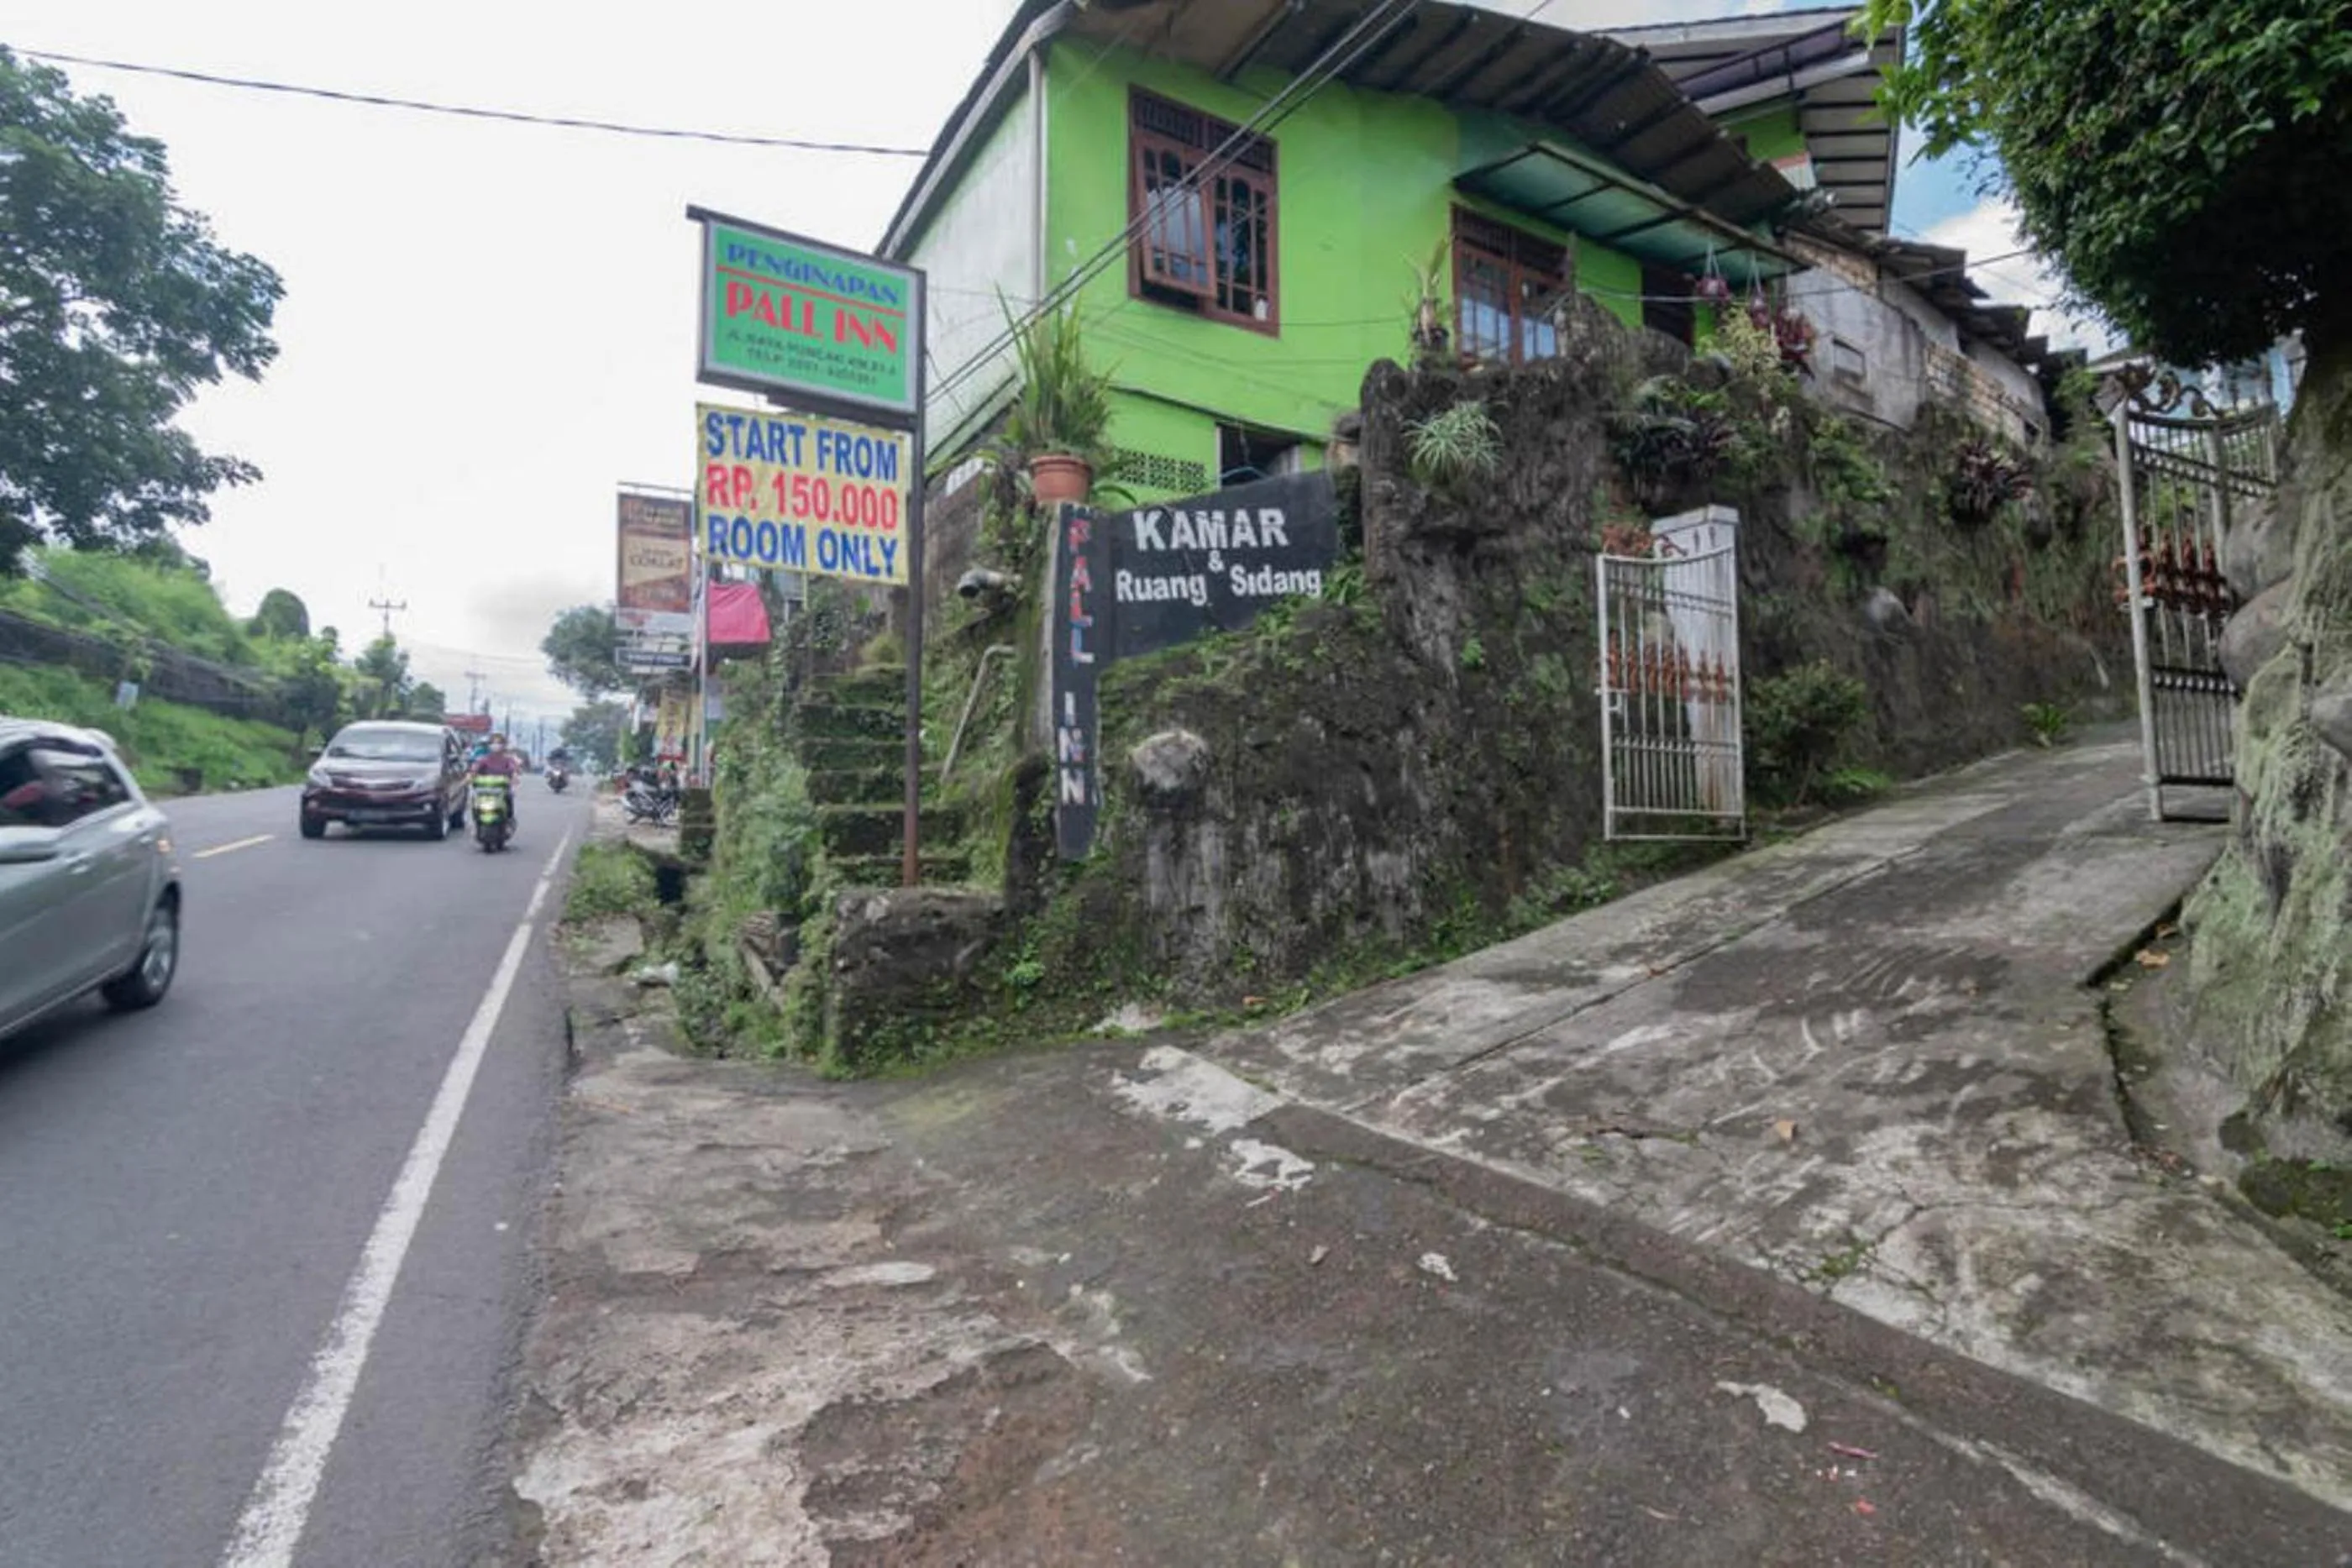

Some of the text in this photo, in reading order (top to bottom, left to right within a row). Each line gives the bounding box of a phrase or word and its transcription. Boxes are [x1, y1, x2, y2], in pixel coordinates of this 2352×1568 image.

[727, 243, 899, 305] PENGINAPAN
[726, 281, 898, 354] PALL INN
[706, 411, 898, 482] START FROM
[706, 462, 898, 531] RP. 150.000
[707, 513, 806, 569] ROOM
[817, 528, 897, 577] ONLY
[1132, 507, 1289, 551] KAMAR
[1208, 550, 1225, 572] &
[1115, 564, 1322, 606] Ruang Sidang
[1058, 517, 1095, 805] PALL INN
